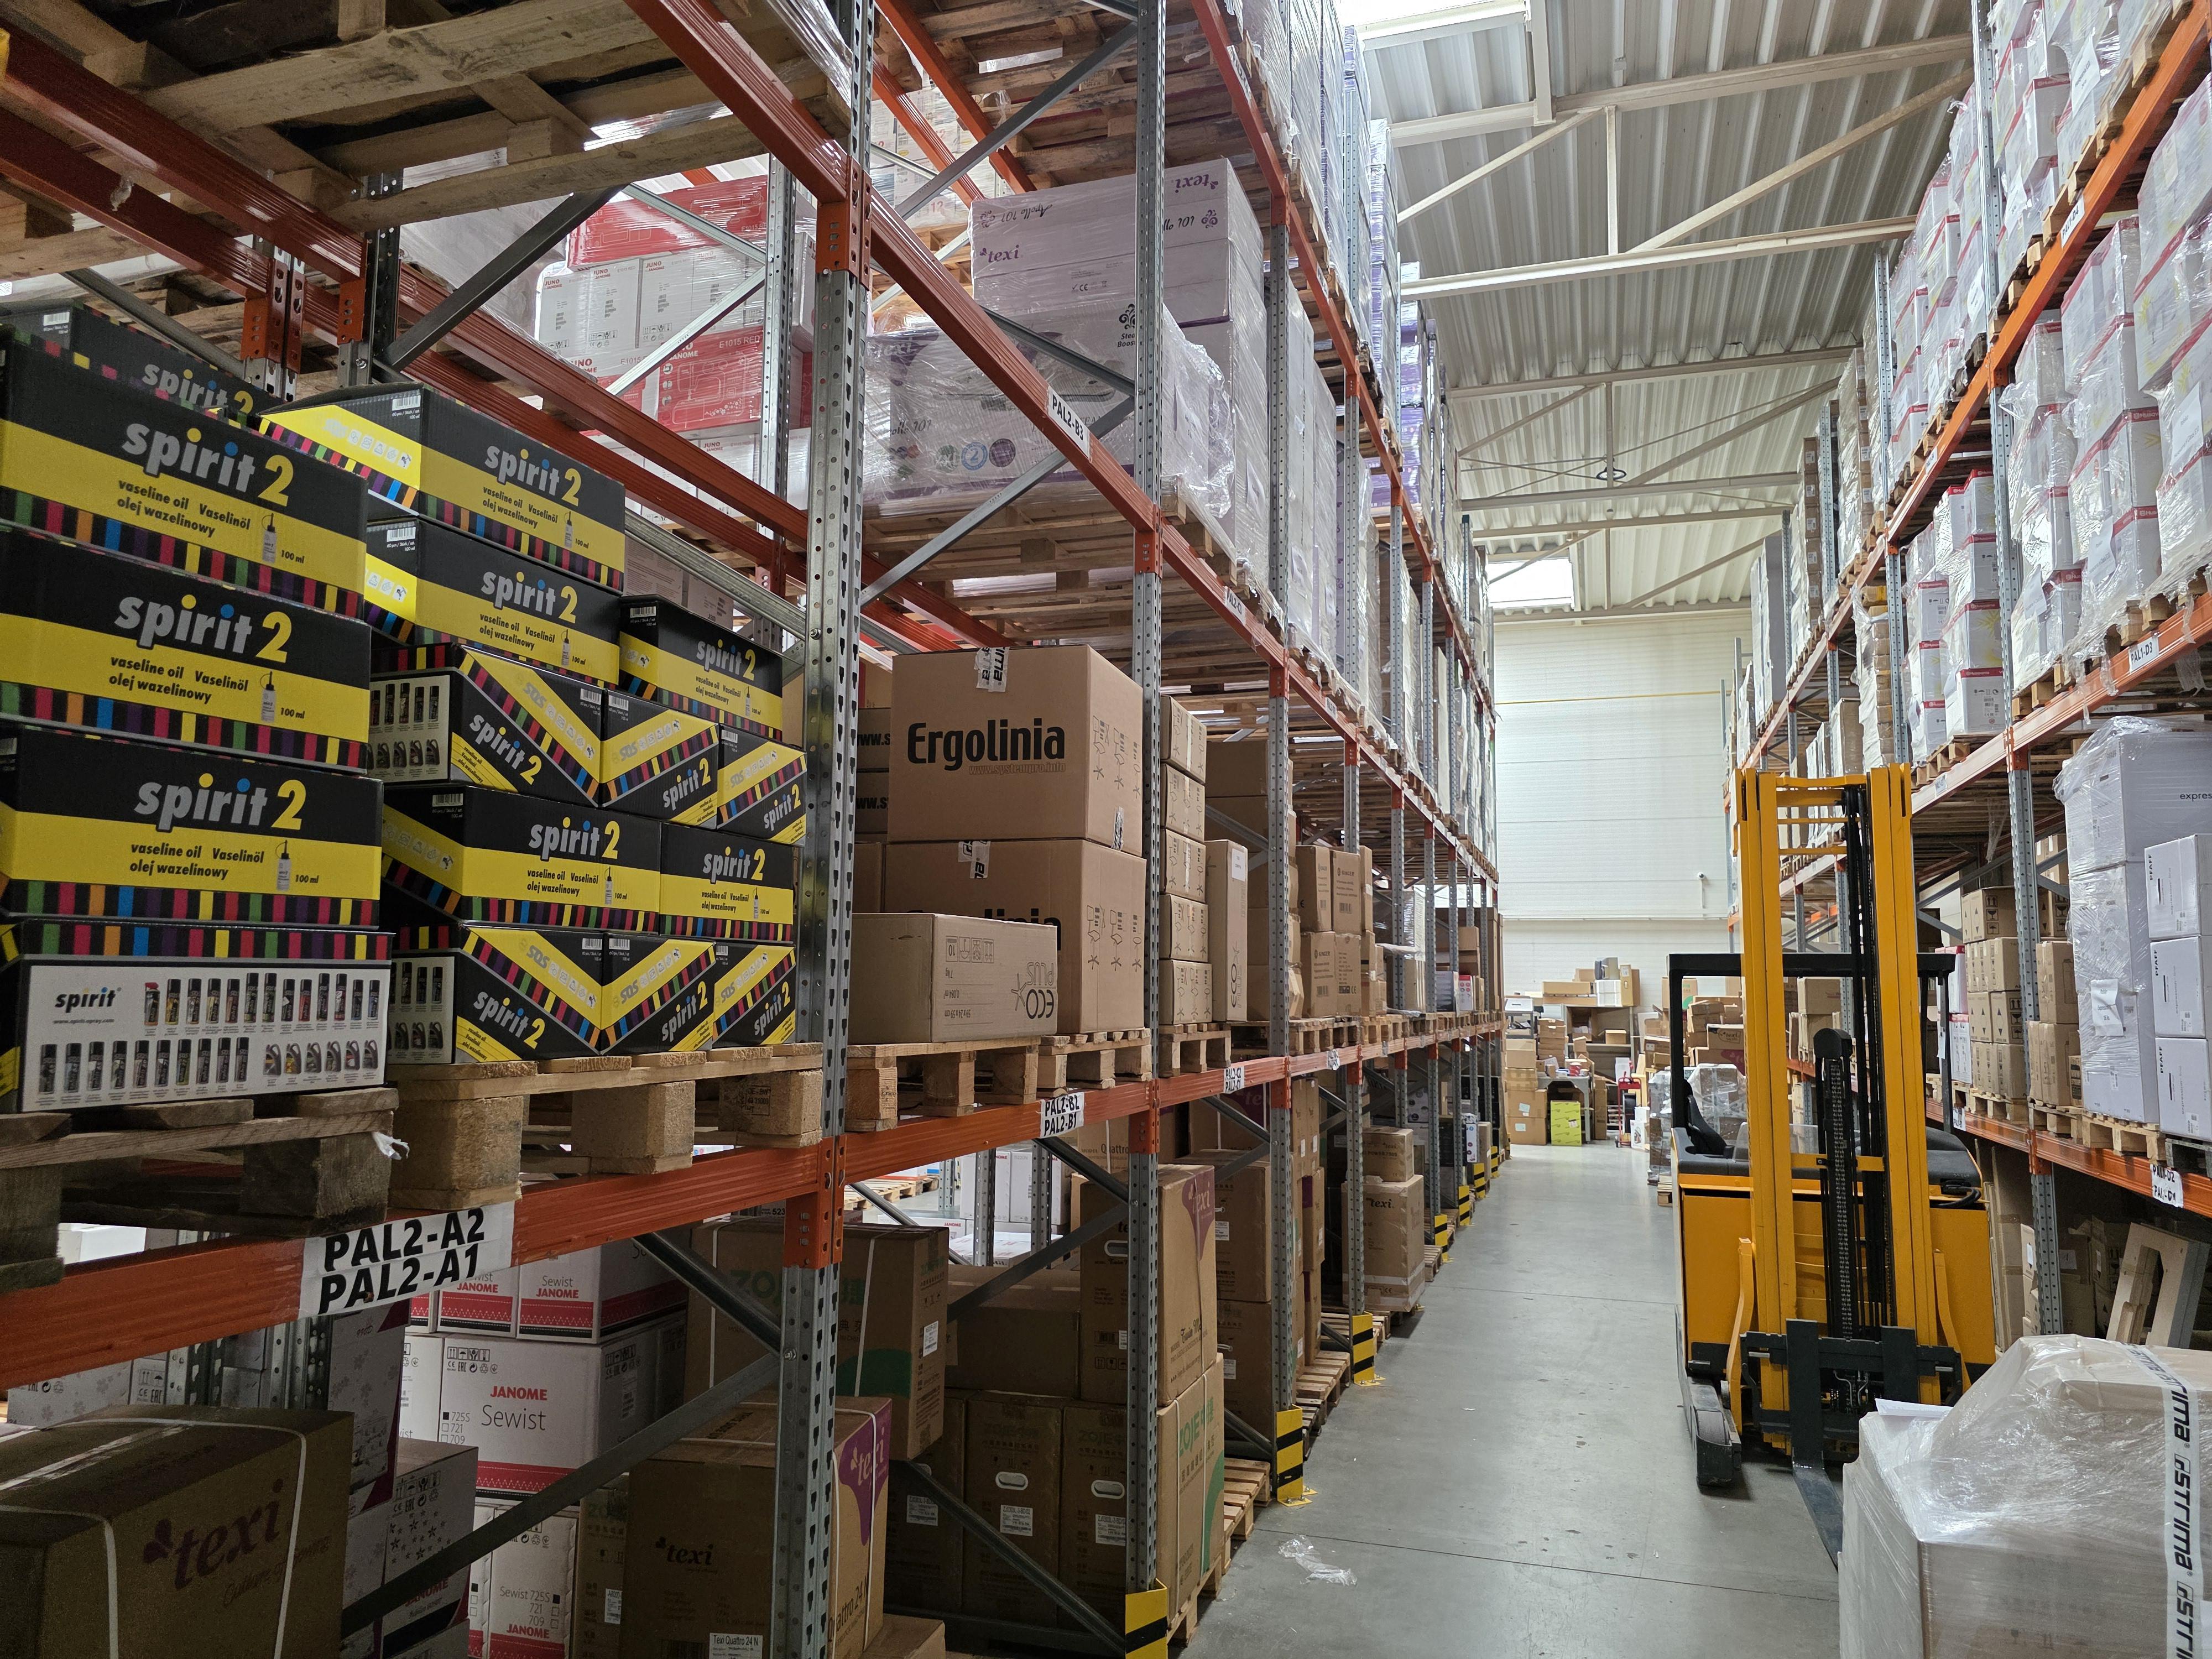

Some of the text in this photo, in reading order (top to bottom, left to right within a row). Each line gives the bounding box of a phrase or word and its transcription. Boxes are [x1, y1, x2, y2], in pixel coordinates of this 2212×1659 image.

[1175, 174, 1209, 193] texi
[1178, 216, 1194, 228] 101
[988, 245, 1020, 263] texi
[719, 336, 760, 348] E1015 RED
[142, 364, 253, 413] spirit 2
[1052, 394, 1084, 441] PAL2-B3
[122, 423, 294, 507] spirit 2
[484, 446, 581, 506] spirit 2
[118, 479, 189, 510] vaseline oil
[483, 487, 523, 508] vaseline oil
[117, 498, 215, 538] olej wazelinowy
[200, 504, 250, 530] Vaselinöl
[483, 499, 538, 529] olej wazelinowy
[528, 504, 558, 523] Vaselinöl
[281, 550, 295, 562] 100
[481, 572, 577, 623] spirit 2
[114, 594, 292, 662] spirit 2
[480, 613, 519, 632] vaseline oil
[480, 625, 535, 651] olej wazelinowy
[526, 626, 555, 643] Vaselinöl
[696, 639, 755, 681] spirit 2
[2131, 641, 2152, 664] PAL1-D3
[111, 656, 184, 679] vaseline oil
[109, 674, 211, 703] olej wazelinowy
[195, 670, 248, 691] Vaselinöl
[696, 675, 712, 687] vaseline
[696, 686, 729, 705] olej wazelinowy
[280, 707, 294, 717] 100
[469, 714, 541, 785] spirit 2
[907, 718, 1065, 771] Ergolinia
[663, 758, 711, 811] spirit 2
[134, 773, 306, 831] spirit 2
[764, 784, 800, 830] spirit 2
[529, 817, 620, 860] spirit 2
[131, 843, 201, 858] vaseline oil
[212, 847, 264, 863] Vaselinöl
[130, 861, 228, 879] olej wazelinowy
[528, 868, 556, 879] vaseline
[703, 846, 765, 883] spirit 2
[295, 874, 308, 883] 100
[571, 873, 598, 884] Vaselinöl
[527, 882, 580, 897] olej wazelinowy
[711, 904, 736, 913] wazelinowy
[55, 988, 116, 1013] spirit
[754, 980, 790, 1036] spirit 2
[1026, 989, 1054, 1019] ECO
[473, 992, 545, 1049] spirit 2
[662, 981, 708, 1042] spirit 2
[1045, 1095, 1080, 1117] PAL2-B2
[1044, 1113, 1077, 1136] PAL2-B1
[1100, 1143, 1129, 1155] Qattro
[325, 1207, 484, 1271] PAL2-A2
[317, 1244, 478, 1315] PAL2-A1
[457, 1284, 498, 1293] JANOME
[542, 1275, 573, 1287] Sewist
[536, 1288, 578, 1298] JANOME
[491, 1386, 547, 1401] JANOME
[452, 1412, 470, 1422] 725S
[481, 1405, 546, 1431] Sewist
[451, 1423, 463, 1433] 721
[450, 1434, 465, 1444] 709
[175, 1478, 284, 1590] texi
[500, 1586, 550, 1603] Sewist 725S
[530, 1603, 542, 1614] 721
[529, 1615, 544, 1626] 709
[507, 1624, 550, 1639] JANOME
[713, 1635, 759, 1646] Texi Quattro 24 N
